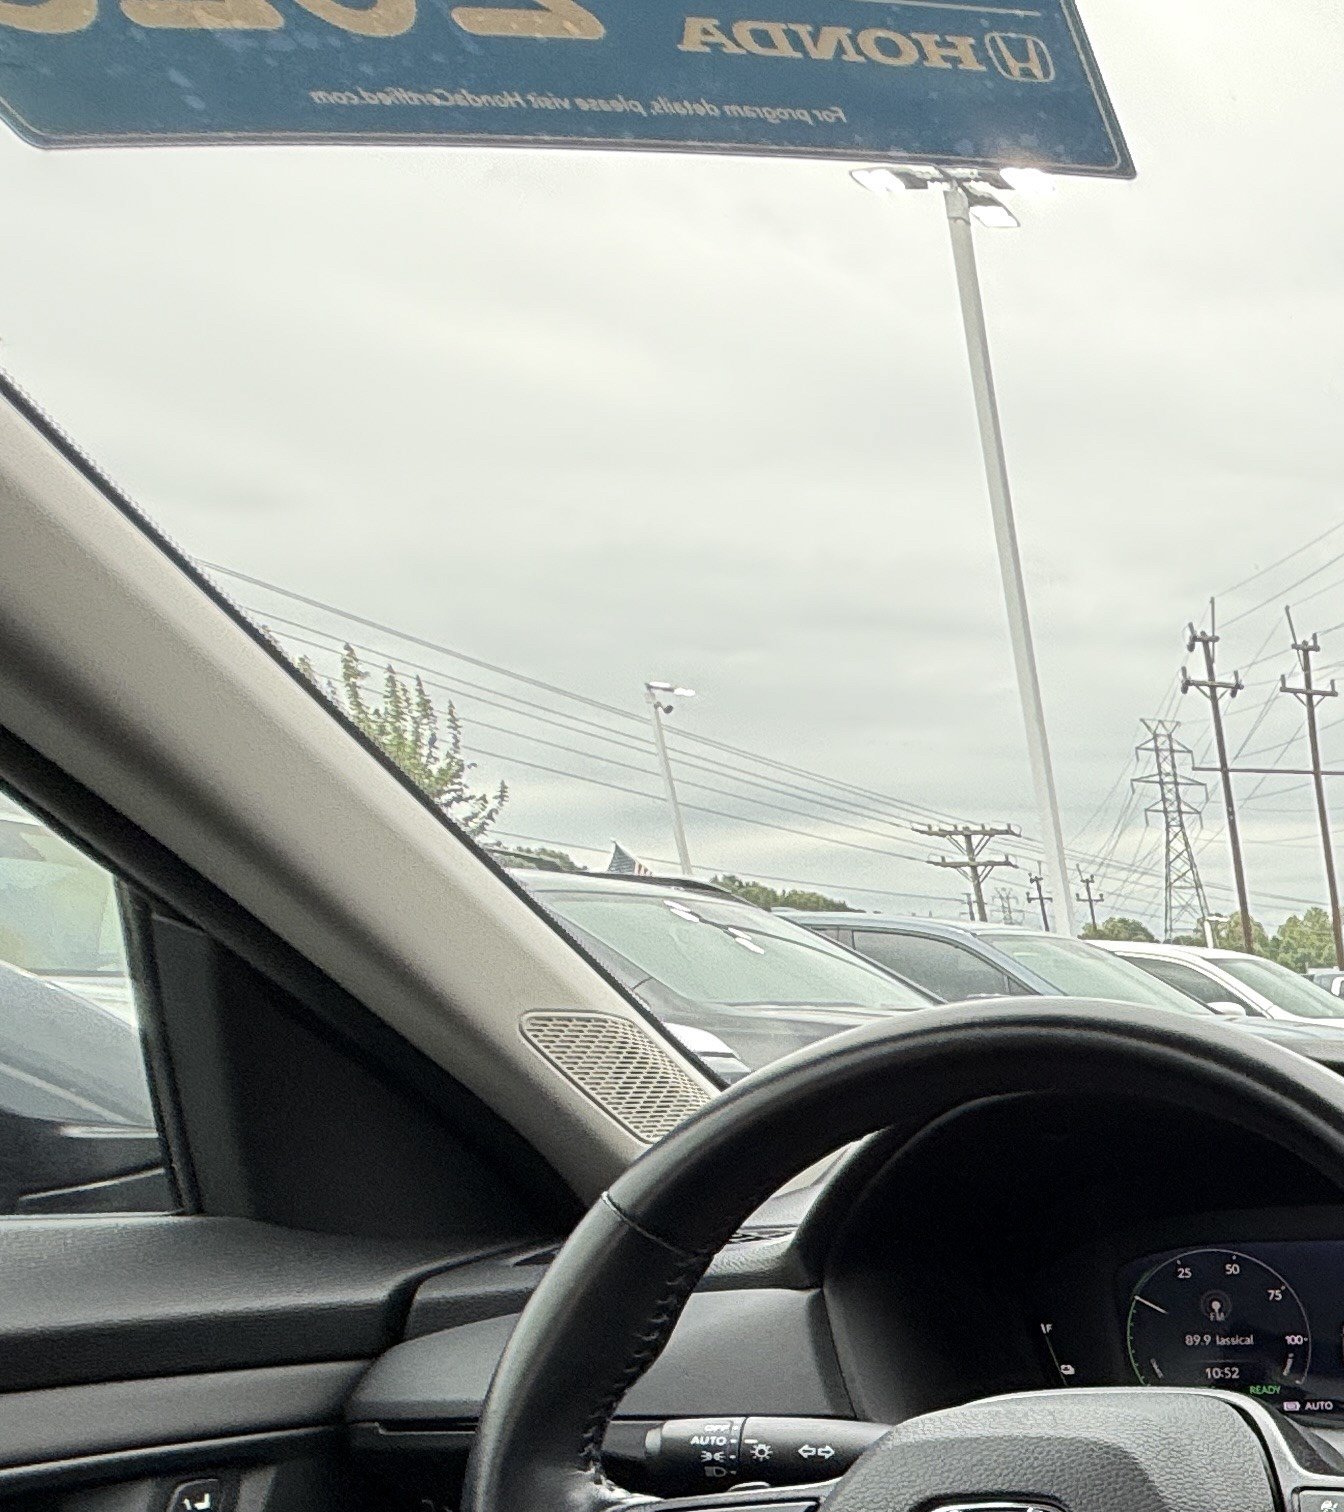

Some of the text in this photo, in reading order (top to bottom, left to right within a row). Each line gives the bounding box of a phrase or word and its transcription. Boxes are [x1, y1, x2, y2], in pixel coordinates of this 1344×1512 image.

[1177, 1268, 1192, 1279] 25
[1225, 1263, 1240, 1275] 50
[1267, 1289, 1282, 1301] 75
[1185, 1334, 1211, 1346] 89.9
[1284, 1335, 1304, 1345] 100
[1205, 1367, 1240, 1379] 10:52
[1249, 1384, 1281, 1395] READY
[1305, 1400, 1334, 1411] AUTO
[704, 1423, 729, 1432] OFF
[690, 1436, 727, 1446] AUTO
[183, 1498, 192, 1510] 1
